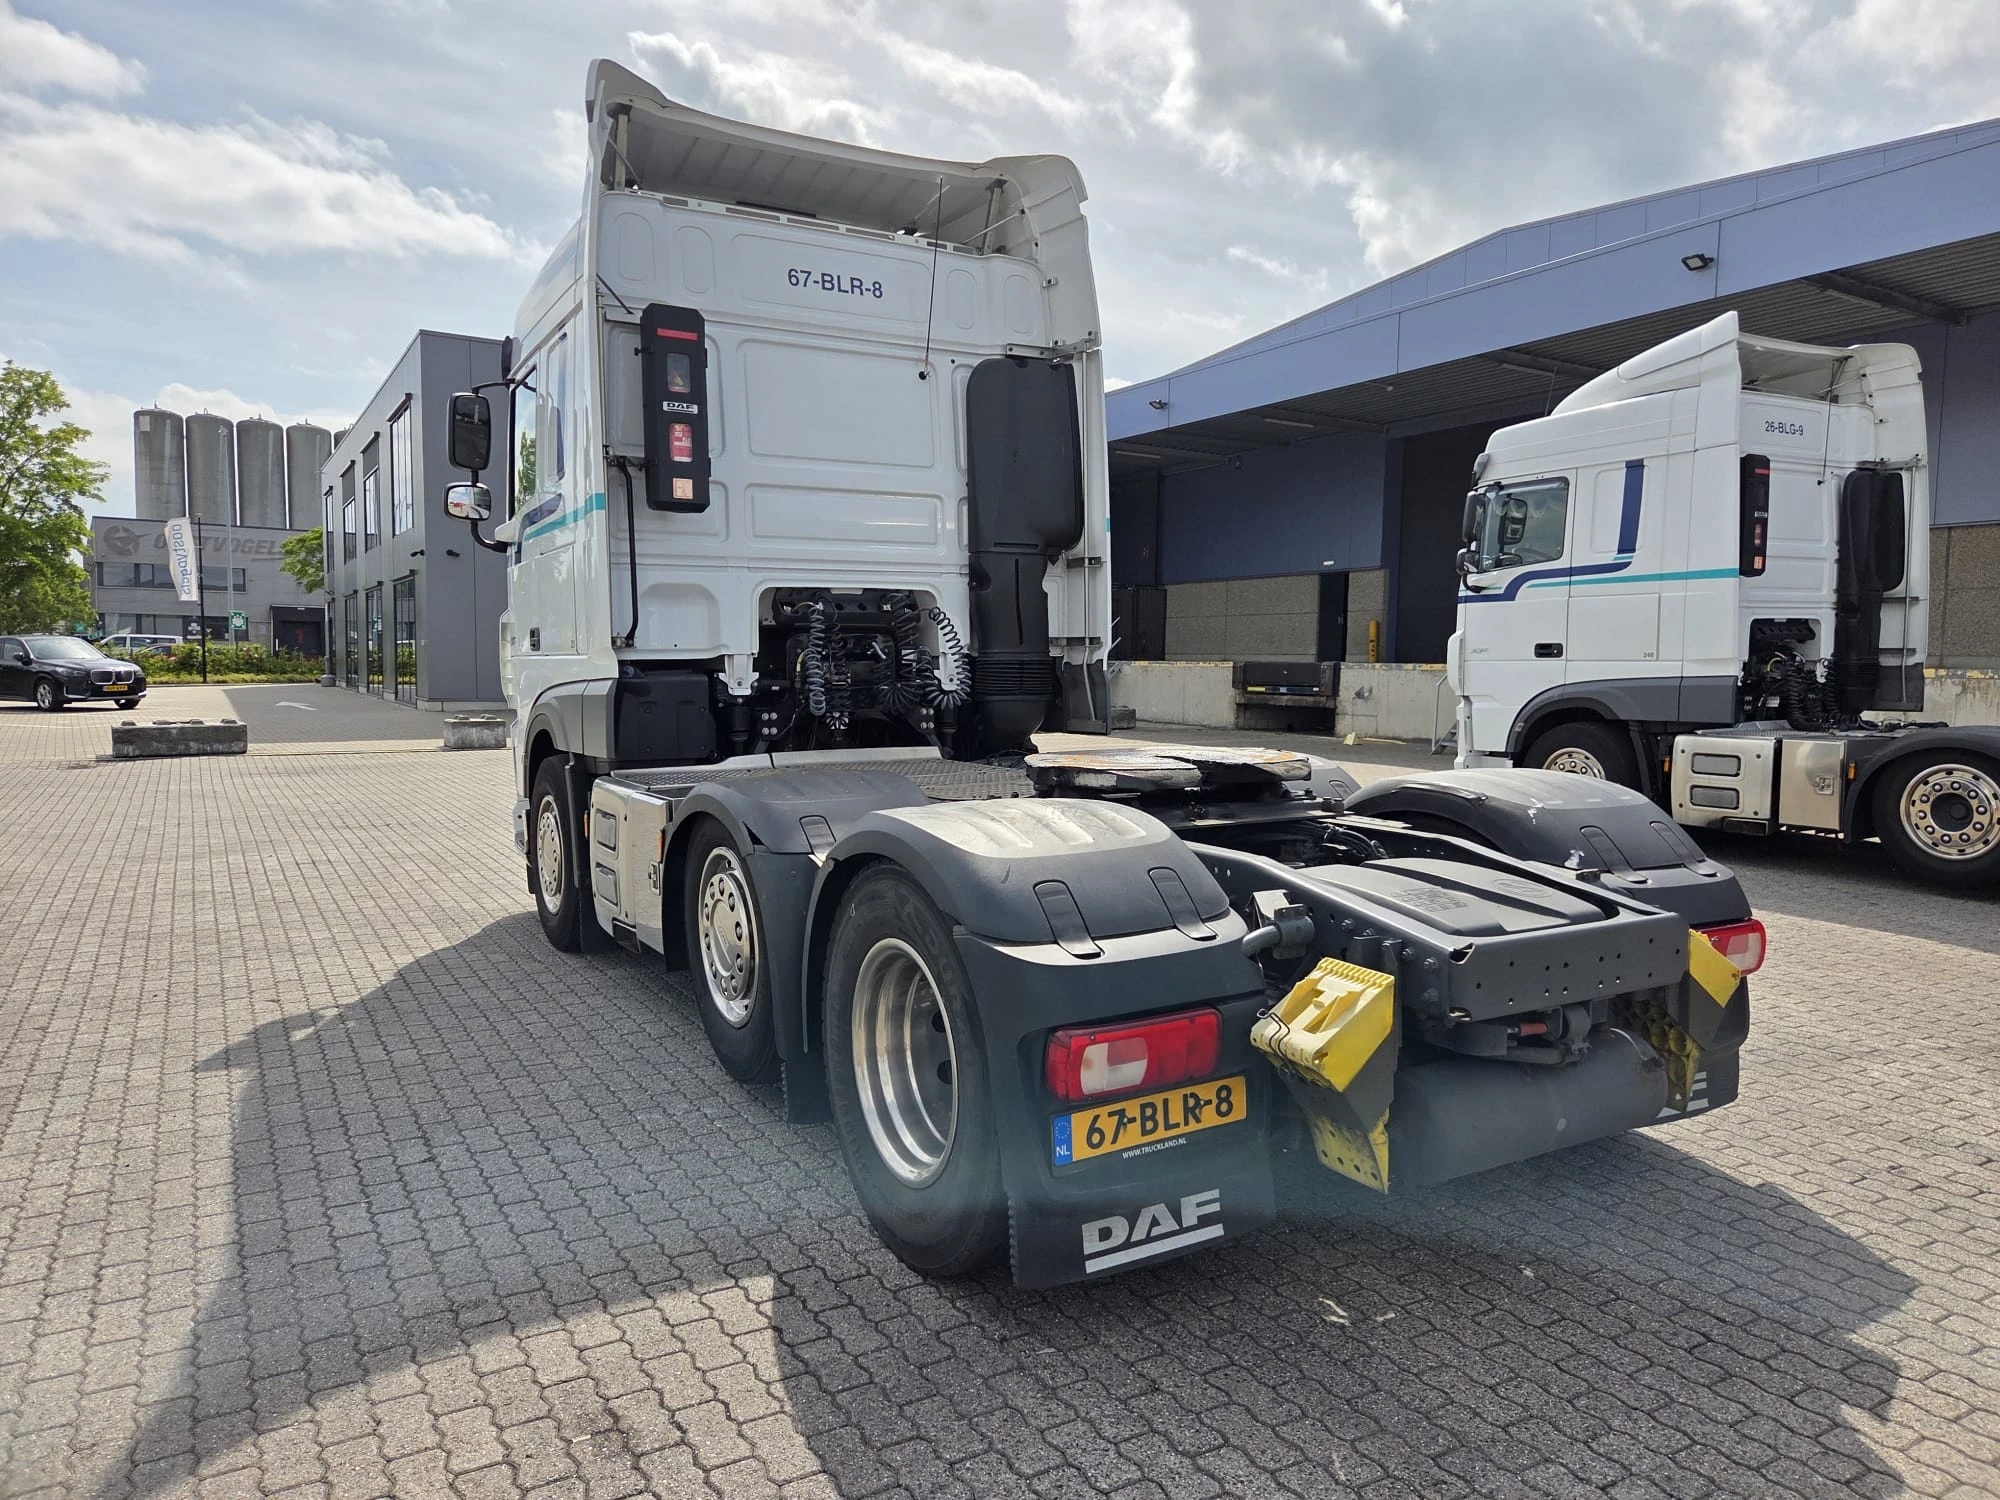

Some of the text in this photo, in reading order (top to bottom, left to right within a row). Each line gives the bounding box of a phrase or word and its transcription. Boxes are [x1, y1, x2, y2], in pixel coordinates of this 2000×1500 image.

[788, 268, 883, 299] 67-BLR-8
[666, 402, 695, 411] DAF
[1765, 421, 1804, 437] 26-BLG-9
[153, 532, 292, 558] OTVOGEL
[1086, 1084, 1233, 1150] 67-BLR-8
[1055, 1145, 1070, 1158] NL
[1121, 1137, 1187, 1160] WWW.TRUCKLAND.NL
[1082, 1188, 1220, 1255] DAF
